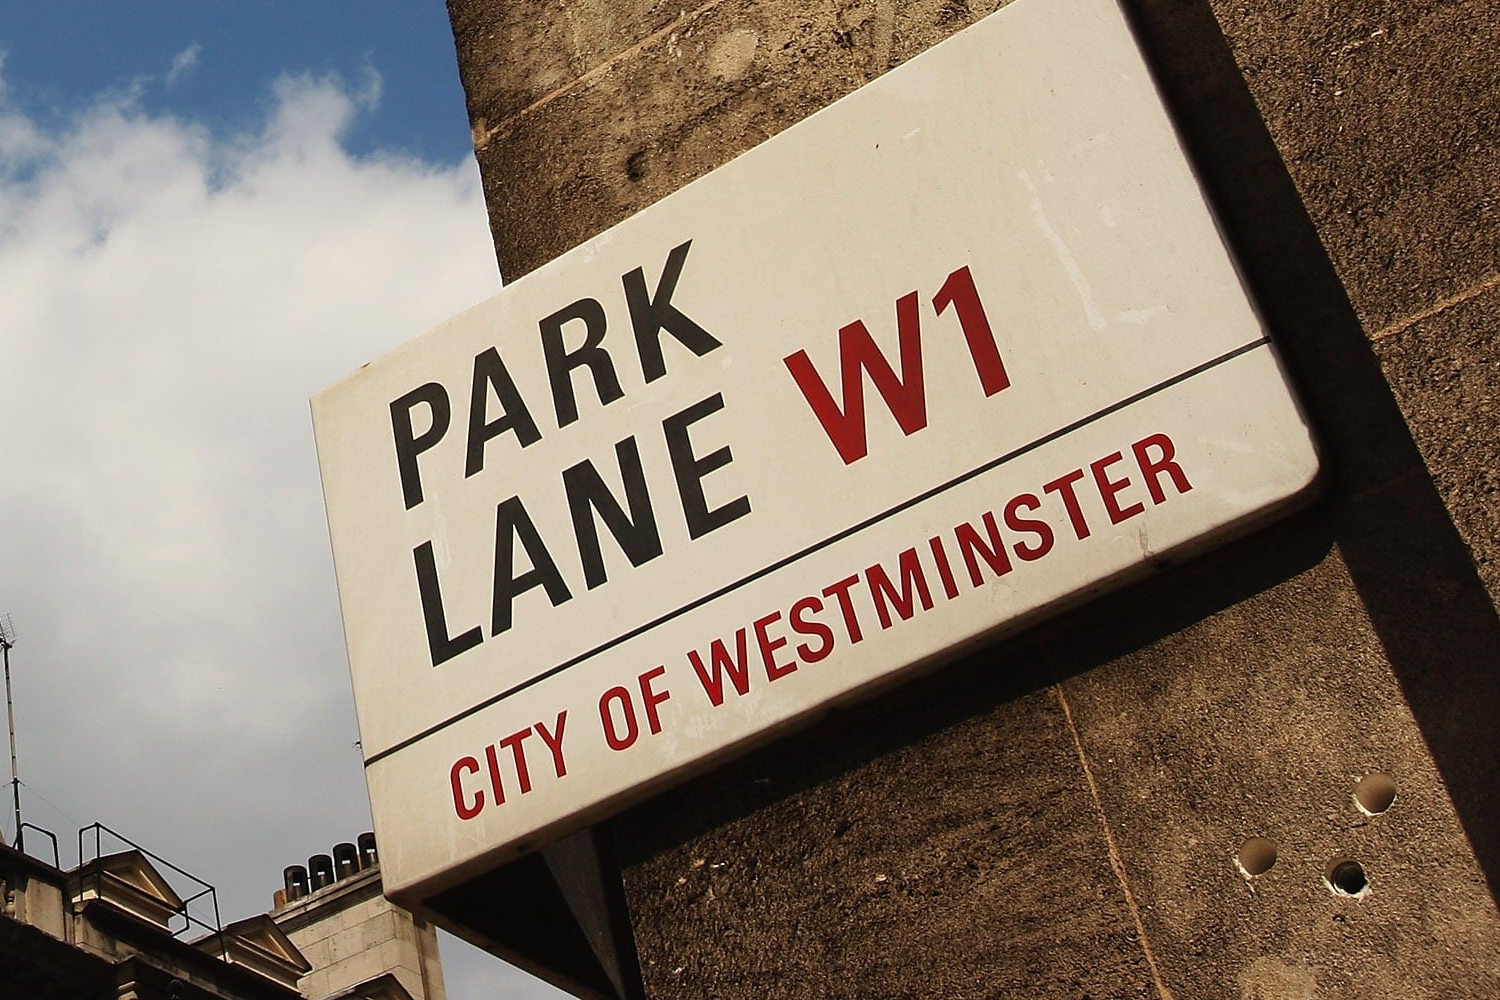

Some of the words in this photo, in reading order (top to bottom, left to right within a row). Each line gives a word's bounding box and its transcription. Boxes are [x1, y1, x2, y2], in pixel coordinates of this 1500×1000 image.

[388, 239, 724, 510] PARK
[783, 265, 1011, 466] W1
[412, 392, 752, 668] LANE
[449, 710, 569, 821] CITY
[598, 666, 673, 752] OF
[687, 432, 1194, 706] WESTMINSTER
